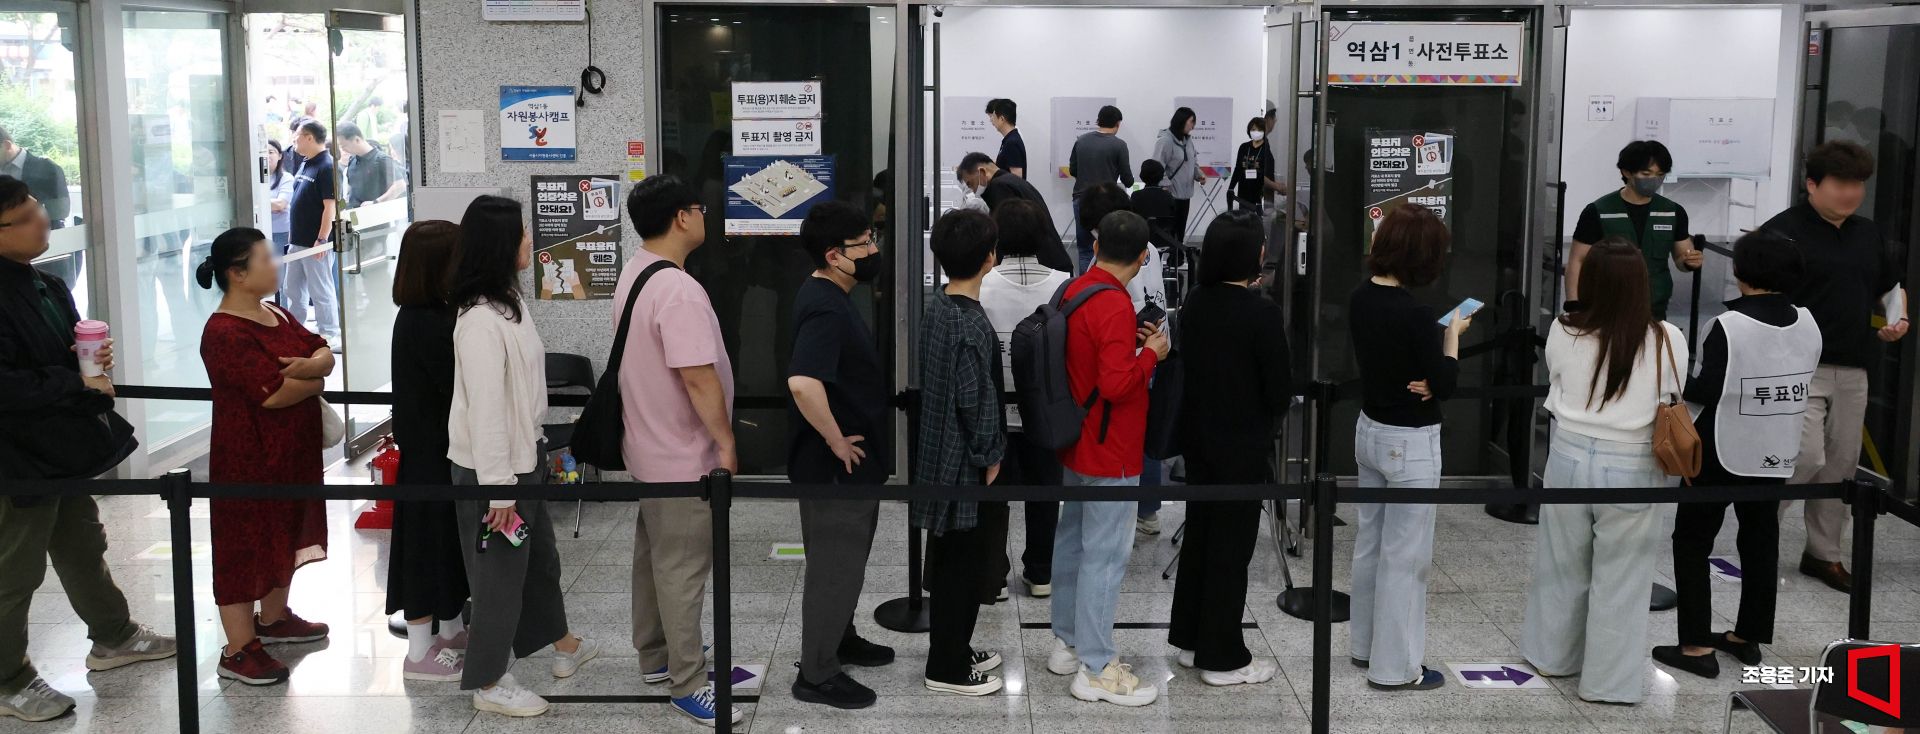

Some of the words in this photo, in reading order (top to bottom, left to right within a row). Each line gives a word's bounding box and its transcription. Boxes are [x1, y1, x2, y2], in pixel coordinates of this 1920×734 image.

[1347, 40, 1400, 62] 역삼1
[1416, 41, 1509, 62] 사전투표소
[737, 94, 778, 105] 투표(용)지
[779, 94, 797, 105] 훼손
[798, 94, 816, 105] 금지
[507, 110, 570, 123] 자원봉사캠프
[740, 132, 770, 142] 투표지
[772, 131, 792, 142] 촬영
[794, 131, 814, 142] 금지
[1371, 137, 1401, 147] 투표지
[1371, 147, 1411, 157] 인증샷은
[1372, 160, 1405, 169] 안돼요!
[537, 182, 567, 191] 투표지
[537, 192, 578, 202] 인증샷은
[540, 204, 572, 213] 안돼요!
[575, 242, 616, 251] 투표용지
[593, 254, 613, 263] 훼손
[1753, 382, 1809, 405] 투표안
